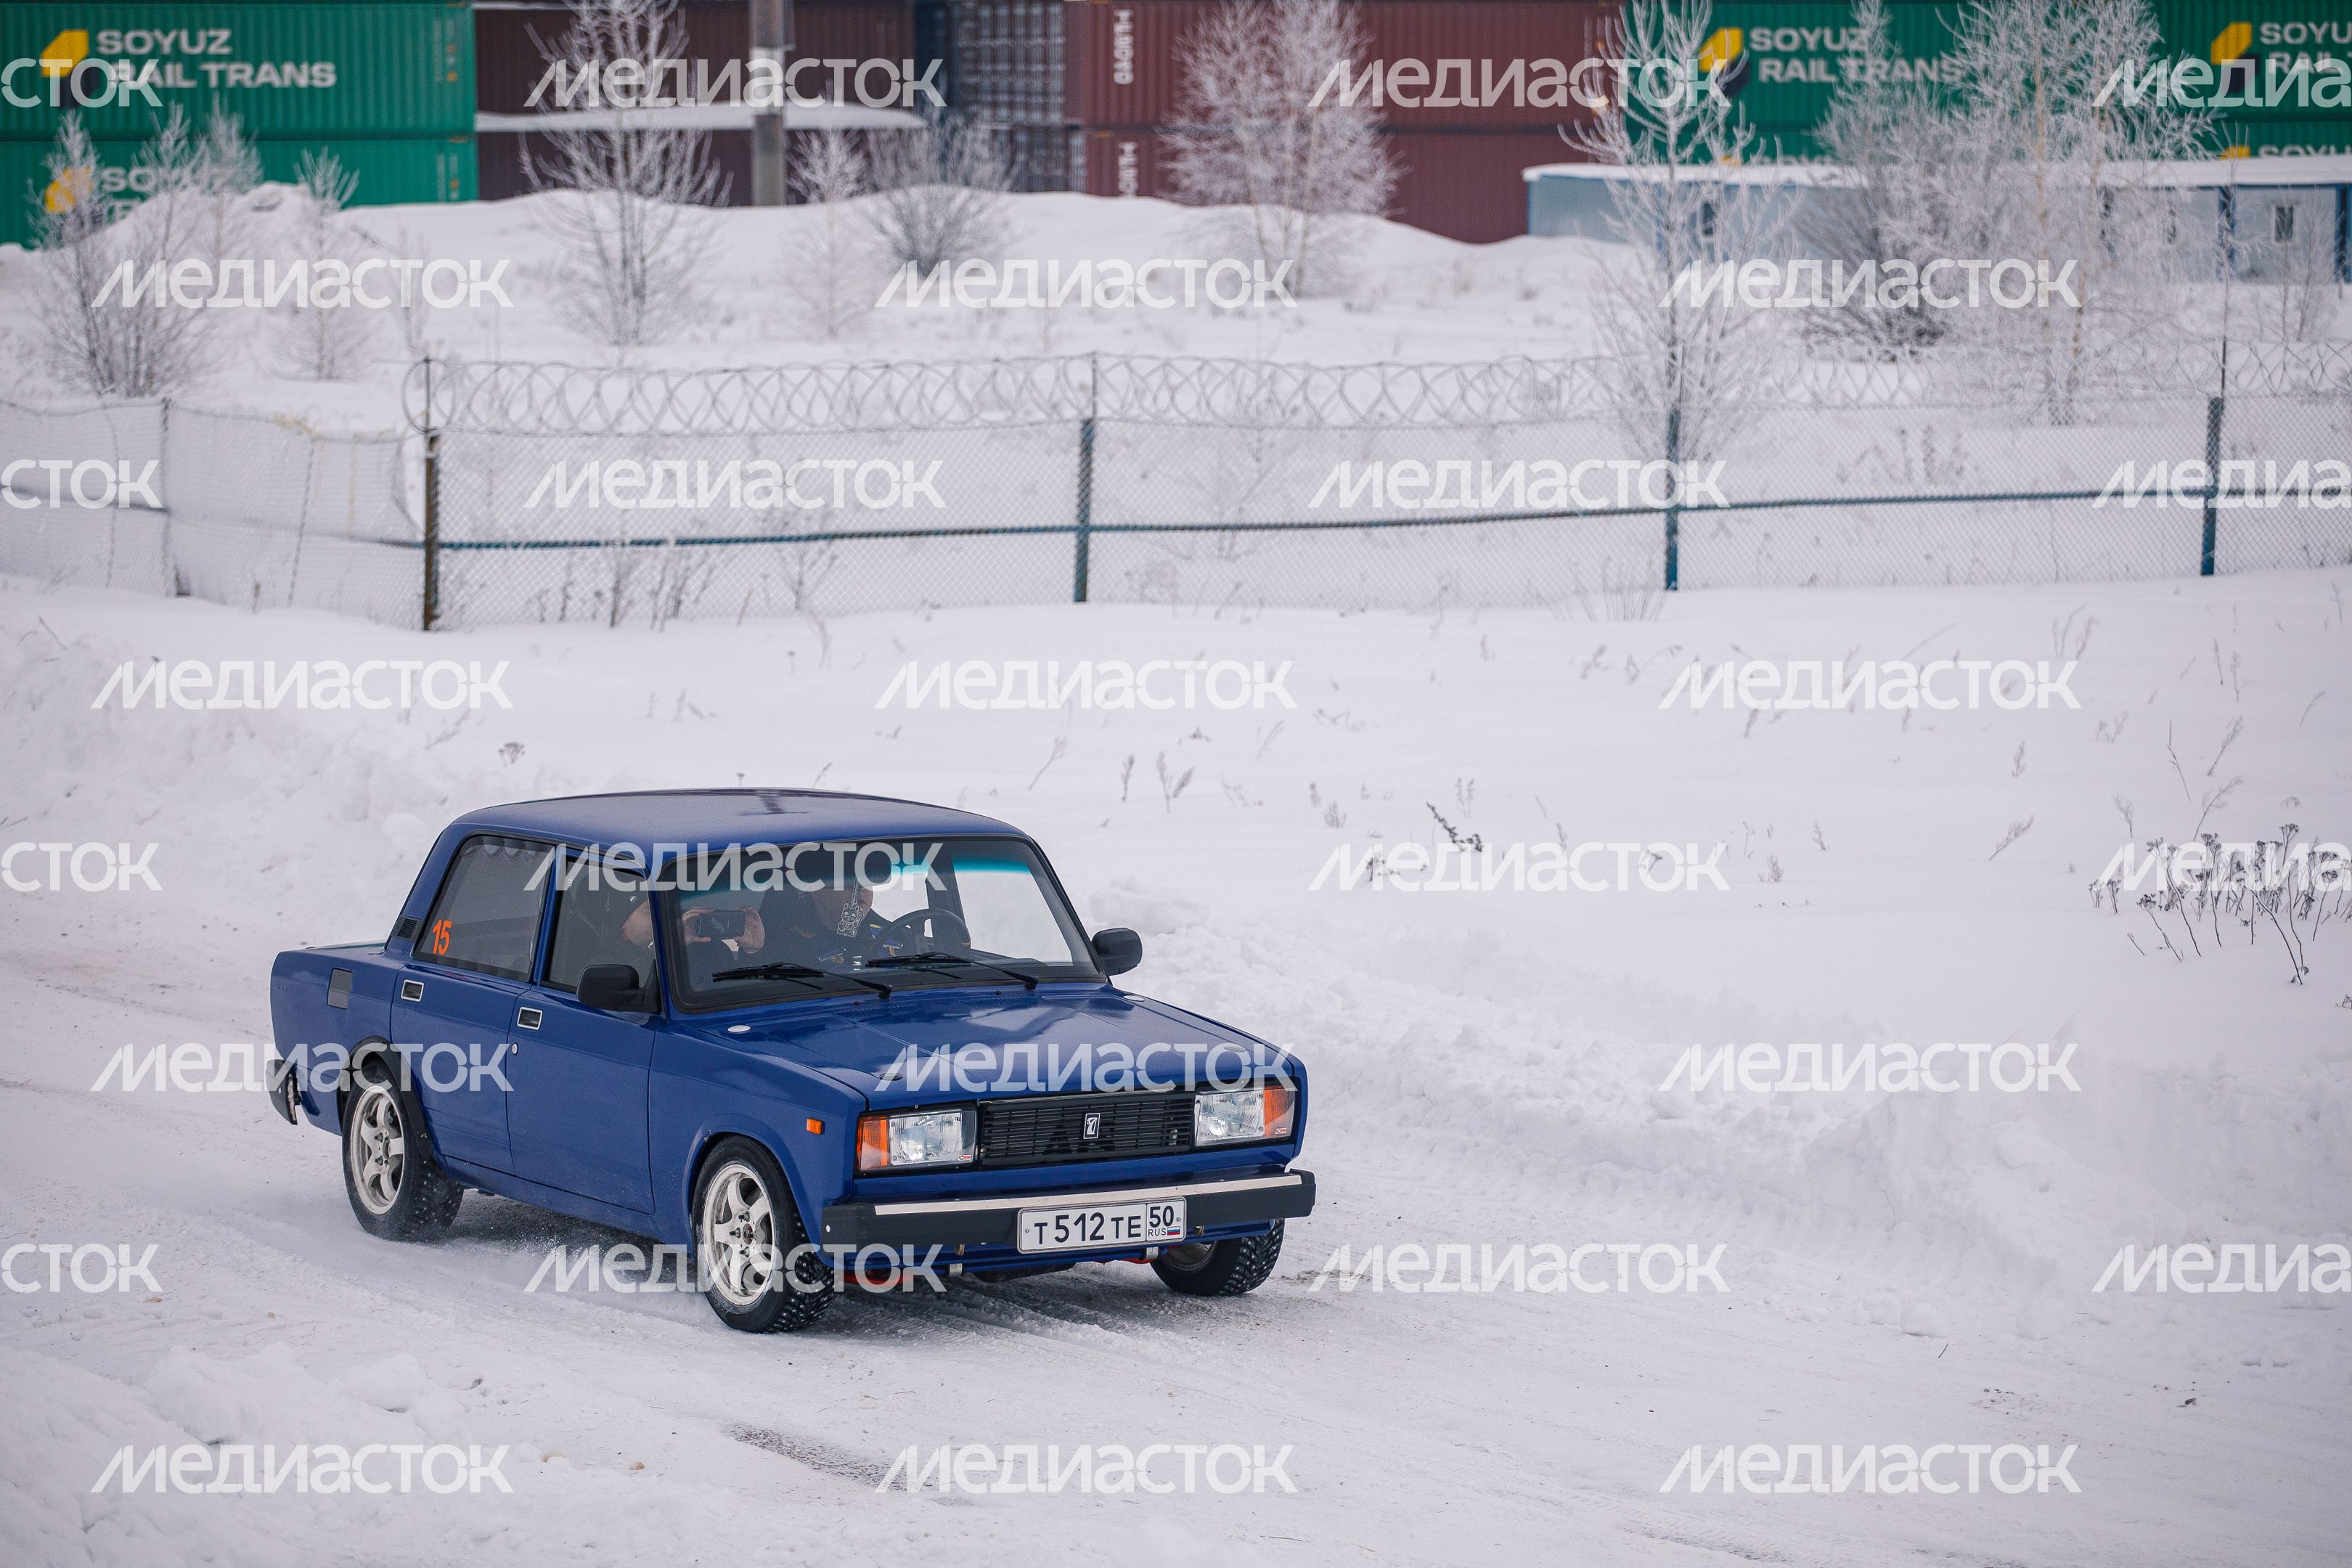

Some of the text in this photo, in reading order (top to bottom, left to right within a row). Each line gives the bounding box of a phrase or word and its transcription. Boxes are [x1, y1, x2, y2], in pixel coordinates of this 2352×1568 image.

[97, 28, 232, 54] SOYUZ
[1749, 27, 1871, 52] SOYUZ
[109, 62, 337, 88] RAIL TRANS
[1758, 57, 1964, 83] RAIL TRANS
[2268, 51, 2343, 75] RAIL
[432, 919, 452, 955] 15
[1149, 1205, 1175, 1228] 50
[1148, 1228, 1167, 1237] RUS
